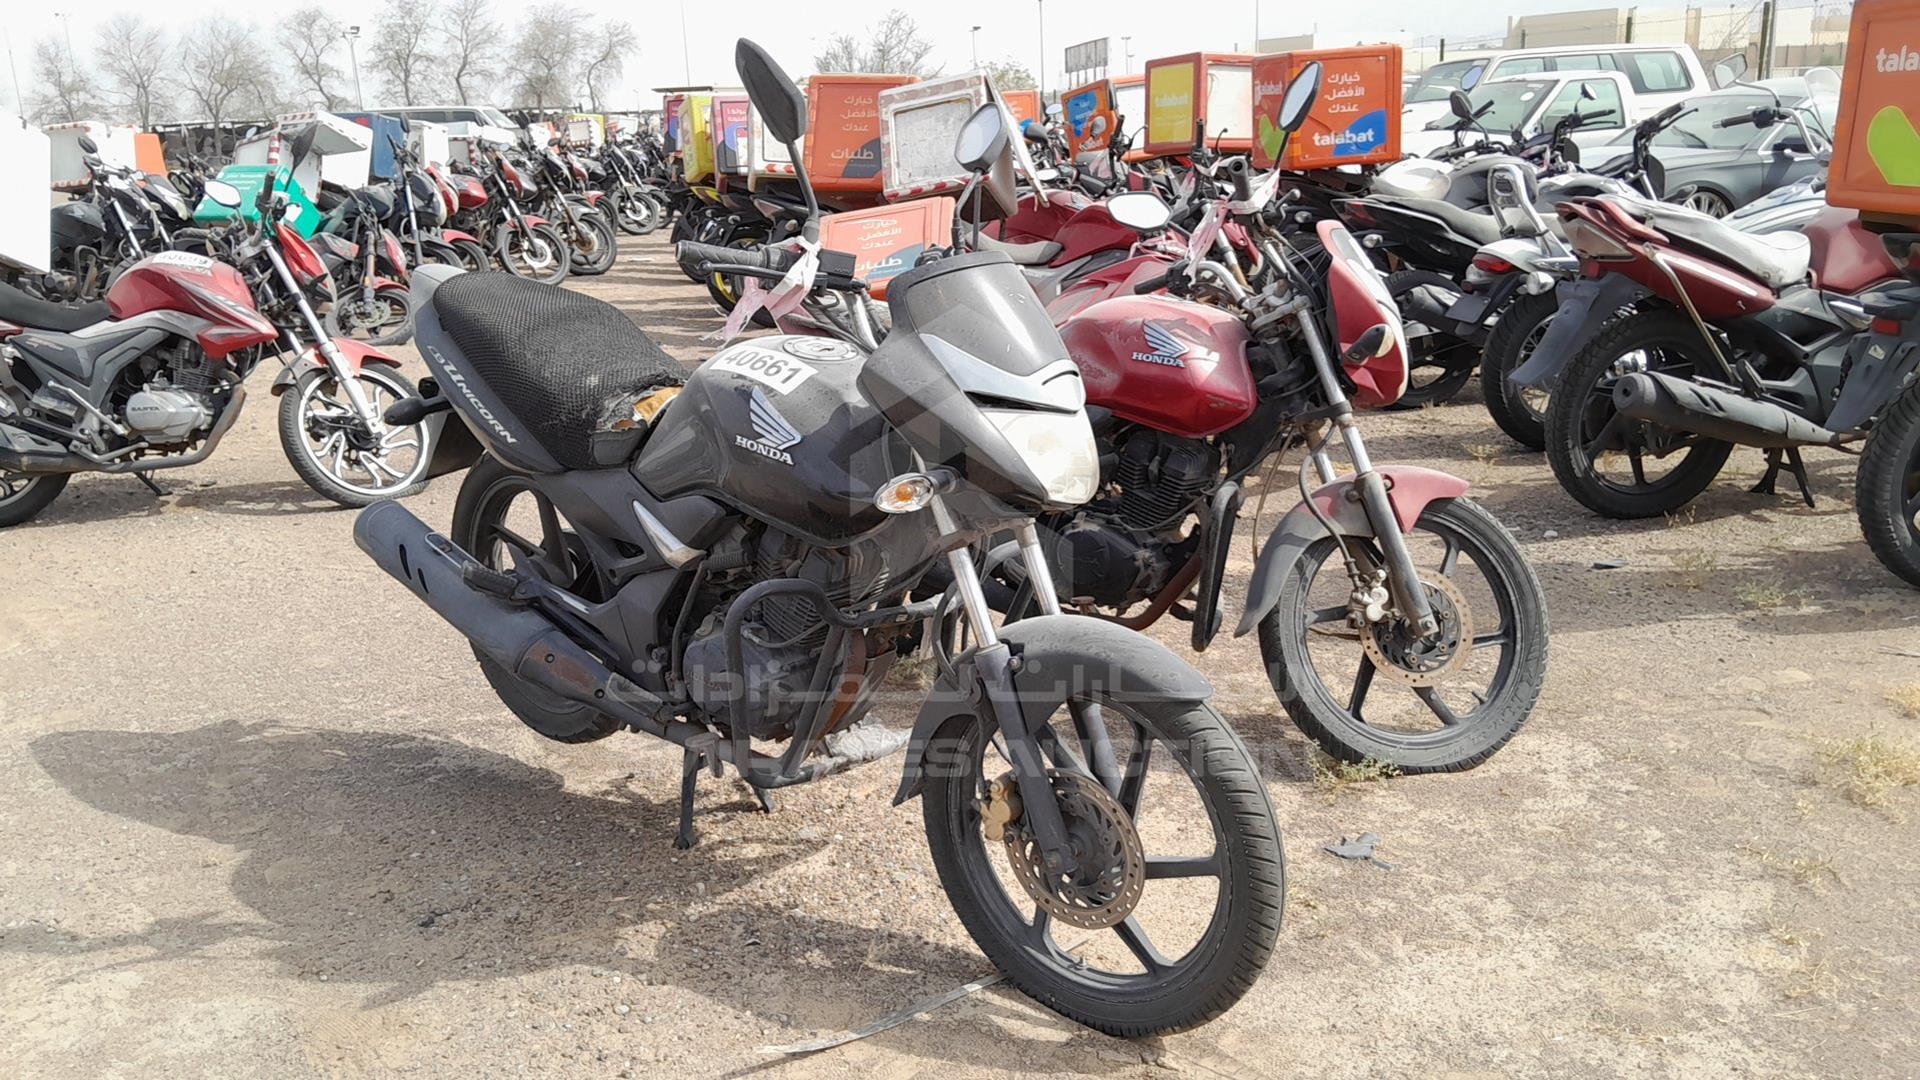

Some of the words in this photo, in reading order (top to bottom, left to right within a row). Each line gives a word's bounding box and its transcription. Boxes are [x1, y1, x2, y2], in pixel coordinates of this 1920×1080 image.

[1875, 44, 1920, 72] tala
[1327, 71, 1361, 85] خيارك
[1328, 102, 1360, 114] عندك
[1312, 128, 1375, 146] talabat
[724, 349, 802, 385] 40661
[1131, 351, 1186, 368] HONDA
[443, 359, 518, 443] UNICORN
[735, 434, 795, 466] HONDA
